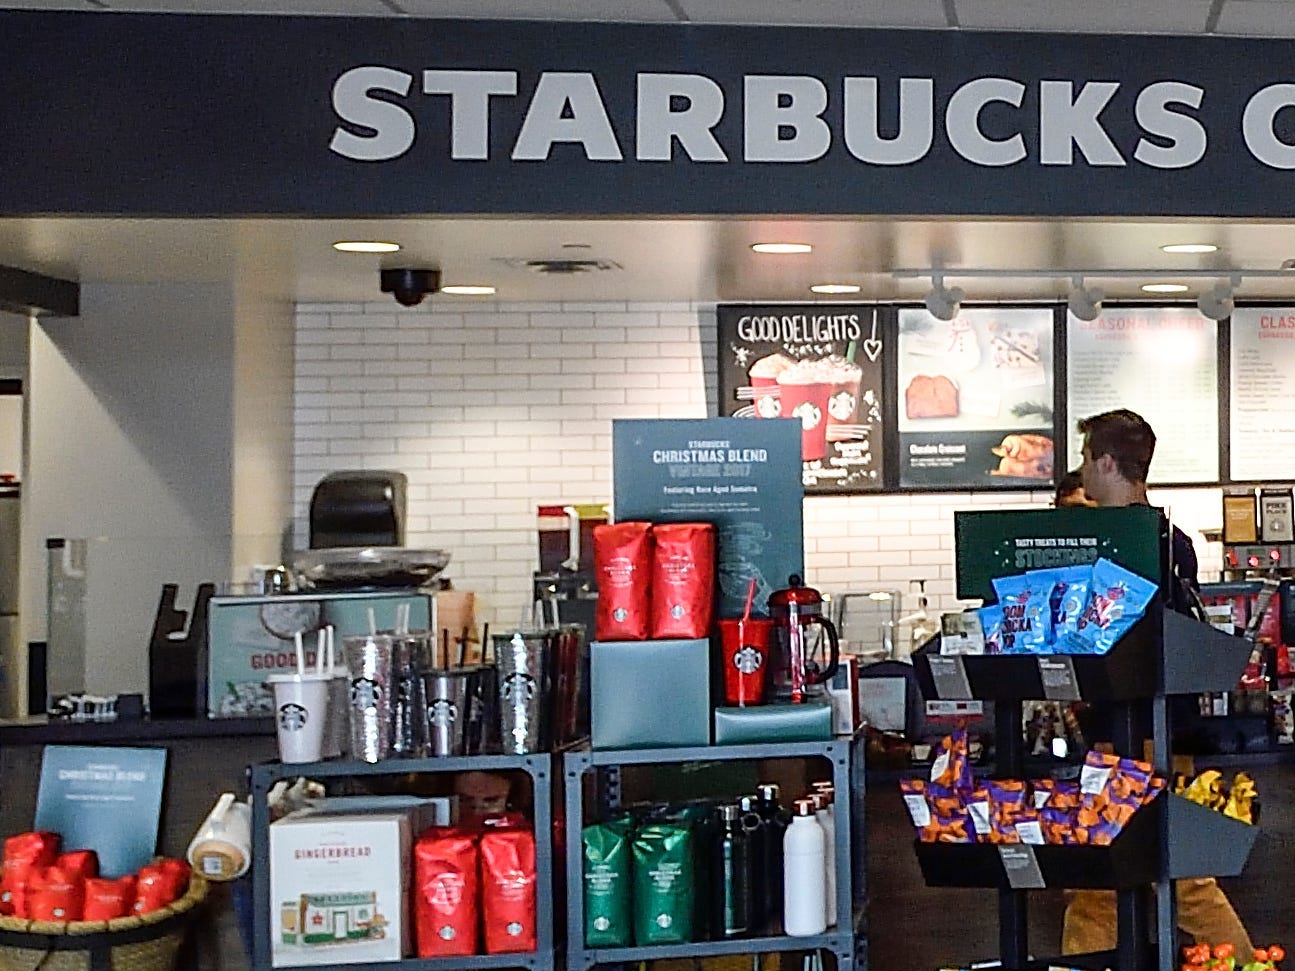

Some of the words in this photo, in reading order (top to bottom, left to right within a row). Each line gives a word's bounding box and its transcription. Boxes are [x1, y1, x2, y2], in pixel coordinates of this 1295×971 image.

[328, 65, 1208, 170] STARBUCKS
[738, 316, 780, 343] GOOD
[782, 314, 861, 343] DELIGHTS
[653, 449, 726, 464] CHRISTMAS
[728, 449, 768, 463] BLEND
[294, 846, 372, 860] GINGERBREAD
